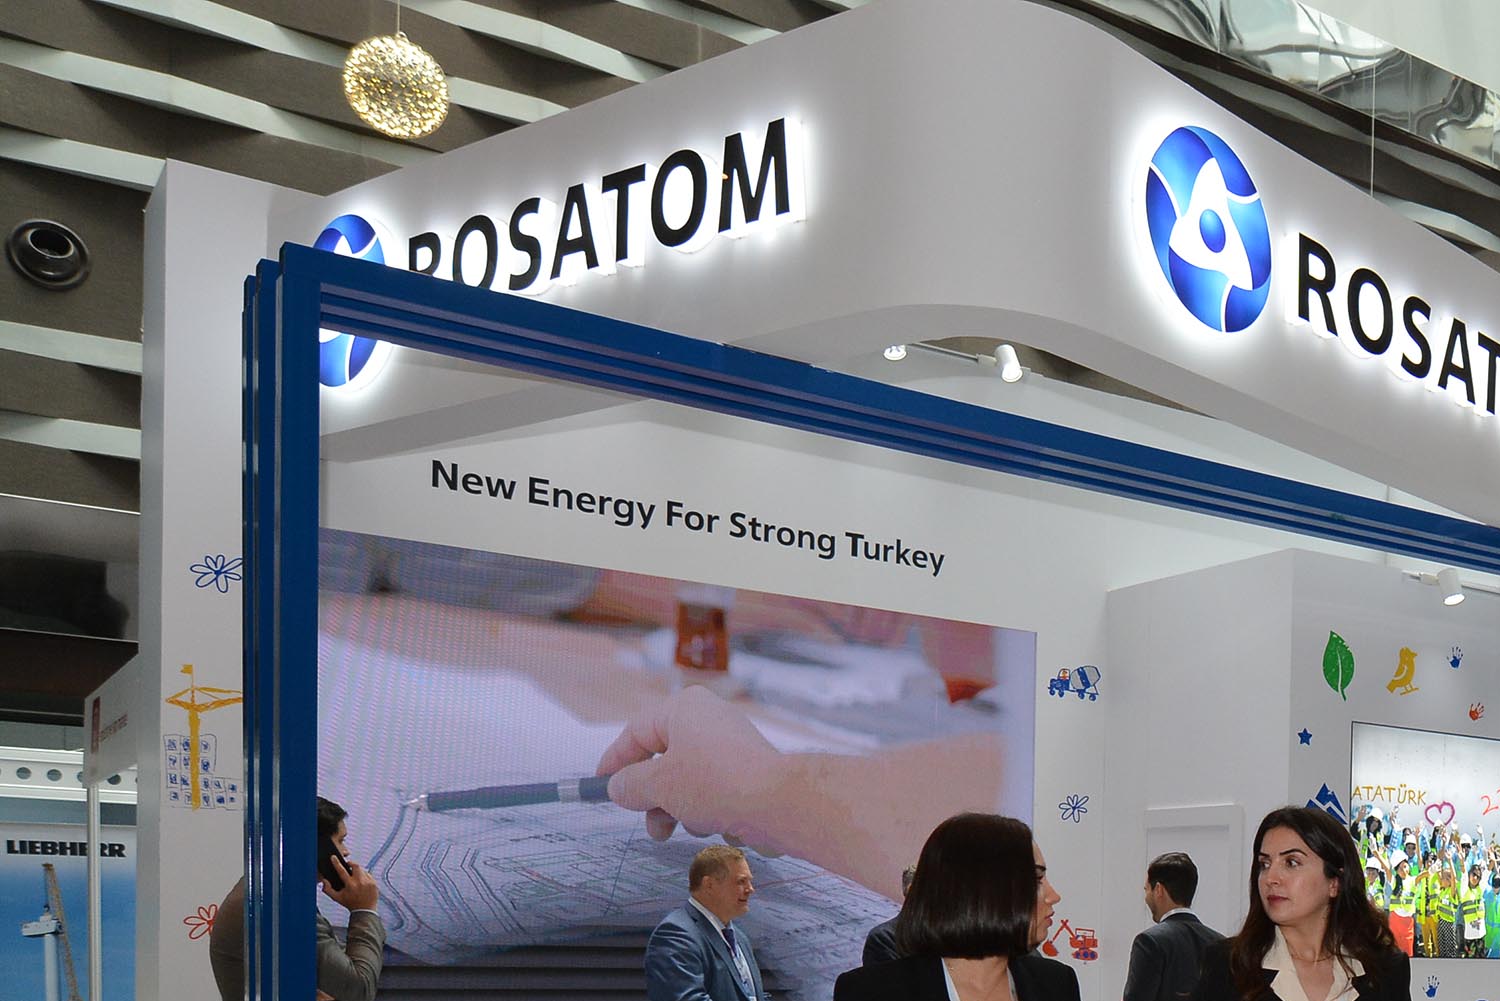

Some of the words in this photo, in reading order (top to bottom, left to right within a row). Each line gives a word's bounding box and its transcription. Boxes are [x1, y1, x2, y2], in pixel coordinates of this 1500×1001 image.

[430, 459, 517, 500] New
[527, 476, 656, 529] Energy
[665, 500, 720, 534] For
[729, 512, 836, 560] Strong
[844, 532, 946, 577] Turkey
